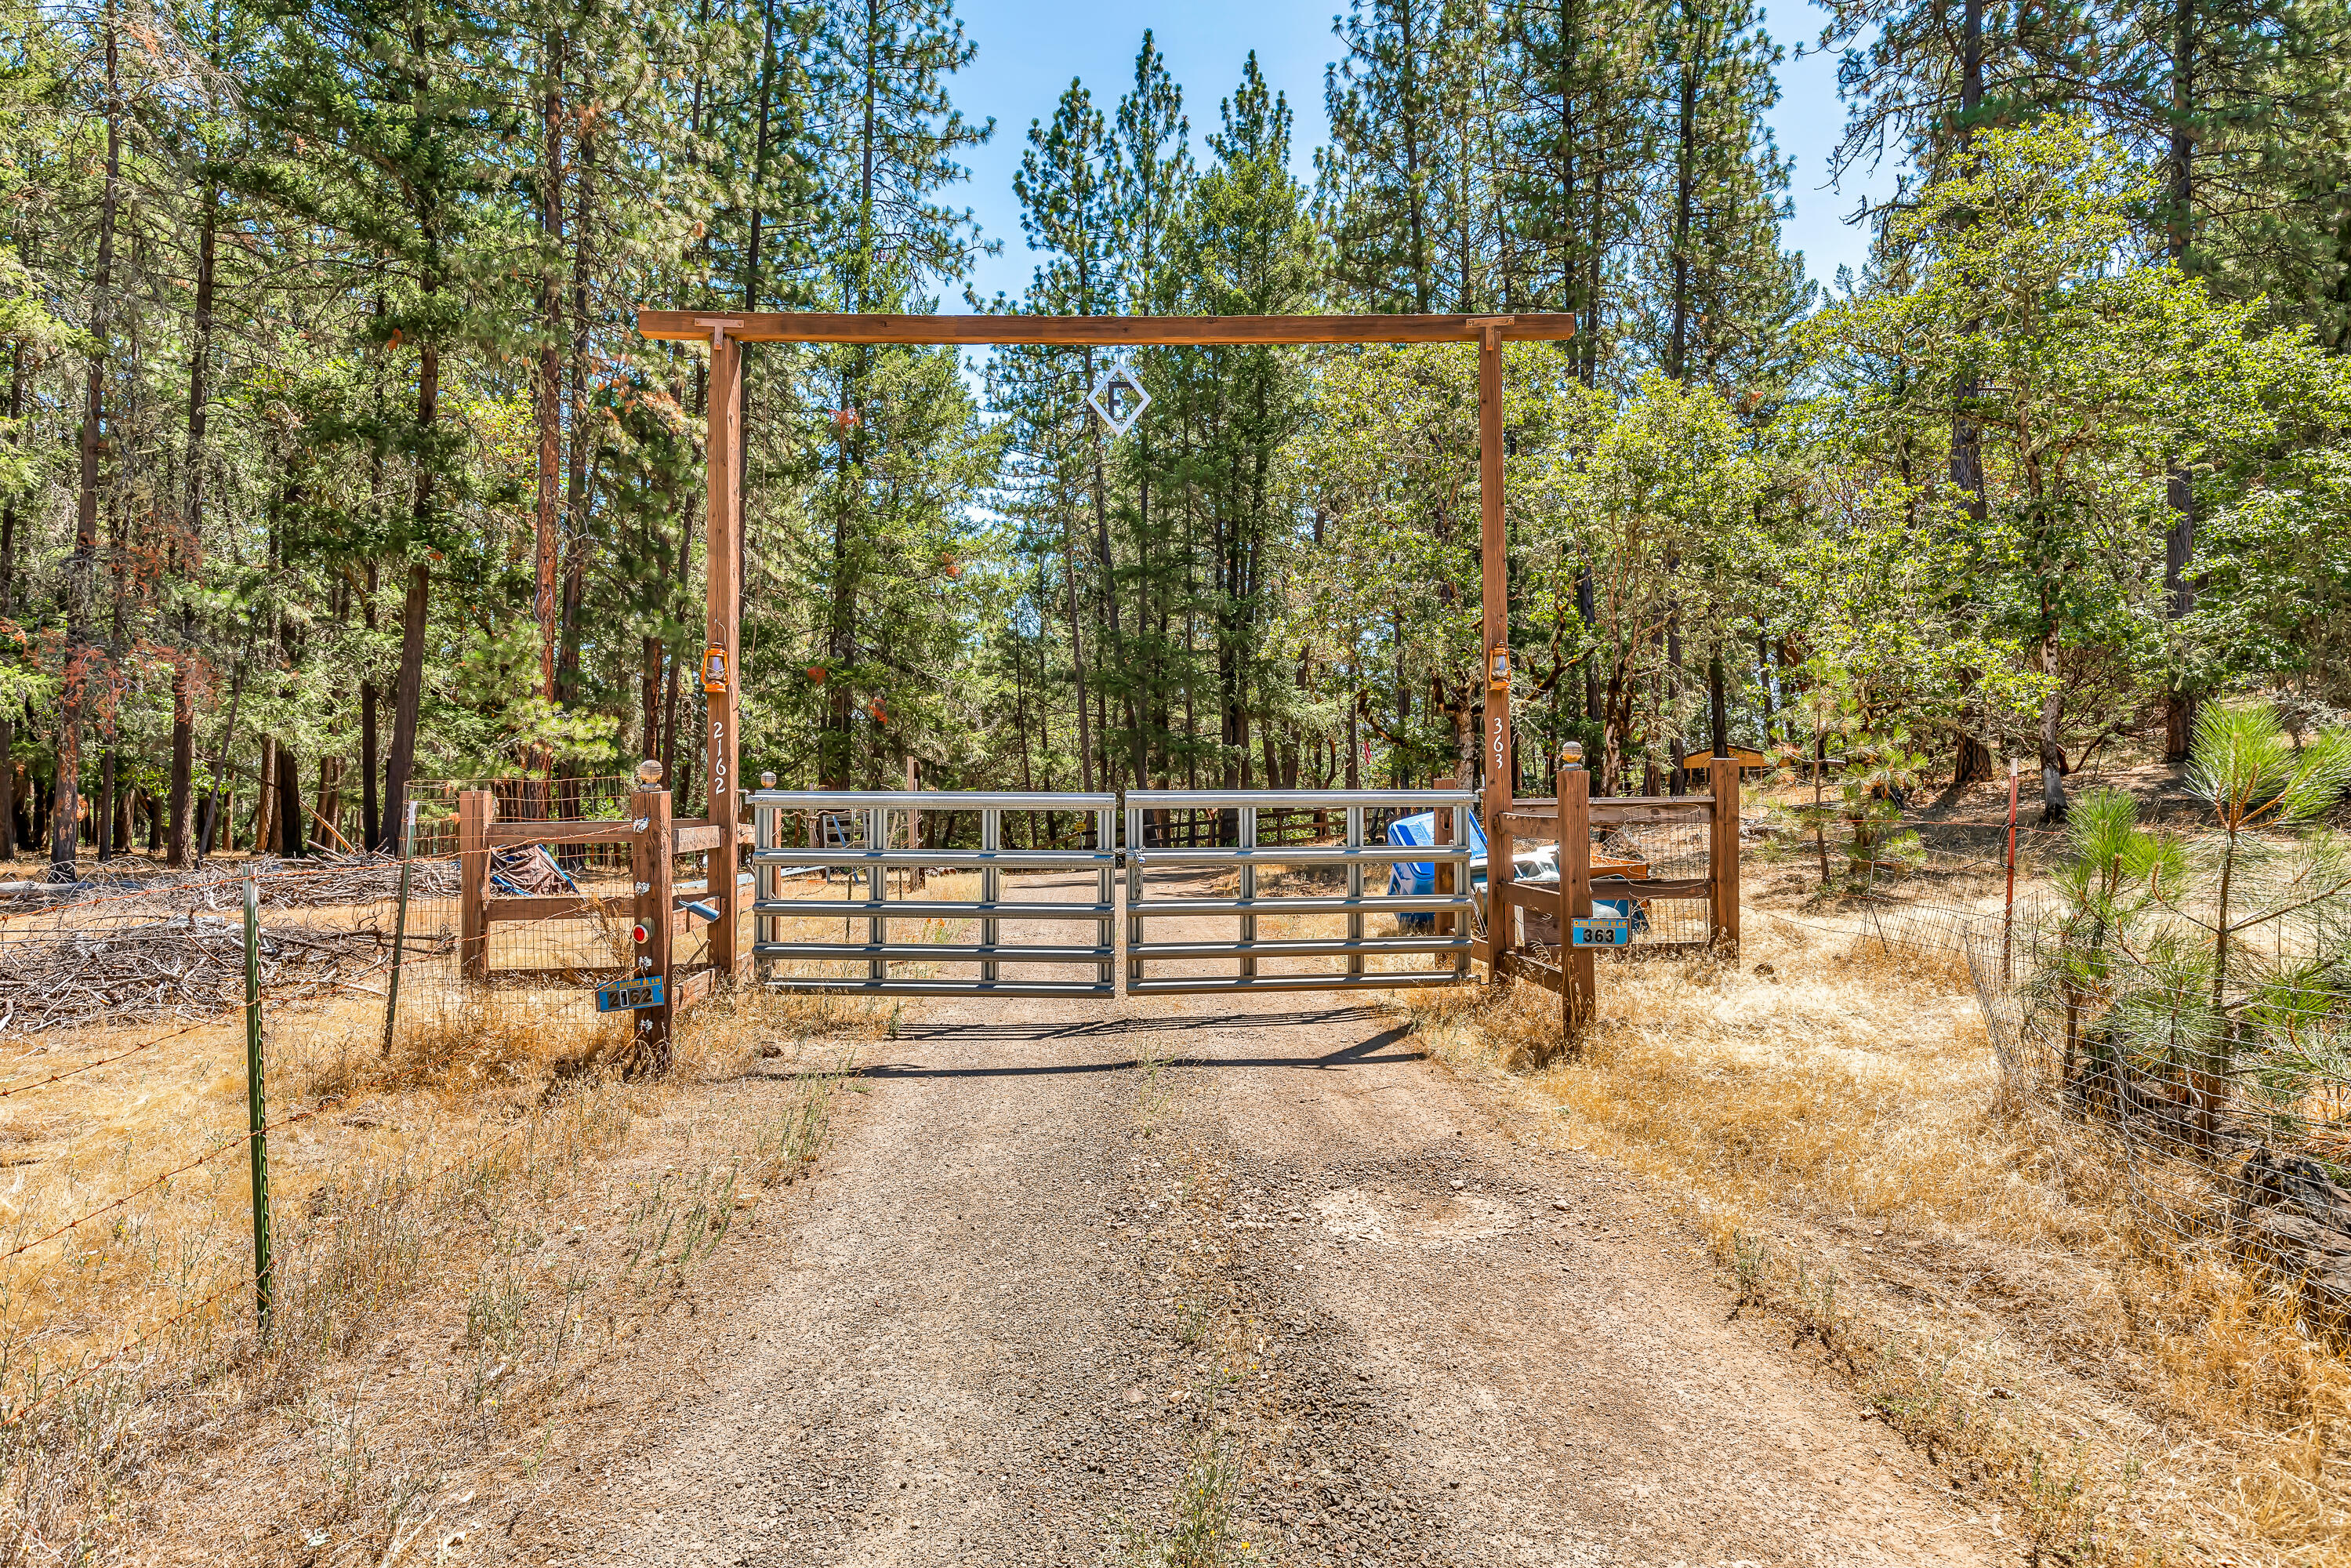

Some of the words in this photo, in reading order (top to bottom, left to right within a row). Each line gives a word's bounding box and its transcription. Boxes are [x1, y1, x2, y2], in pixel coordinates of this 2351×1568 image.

[713, 721, 727, 795] 2162
[1493, 717, 1504, 770] 363
[1584, 928, 1614, 943] 363
[608, 988, 653, 1008] 2162
